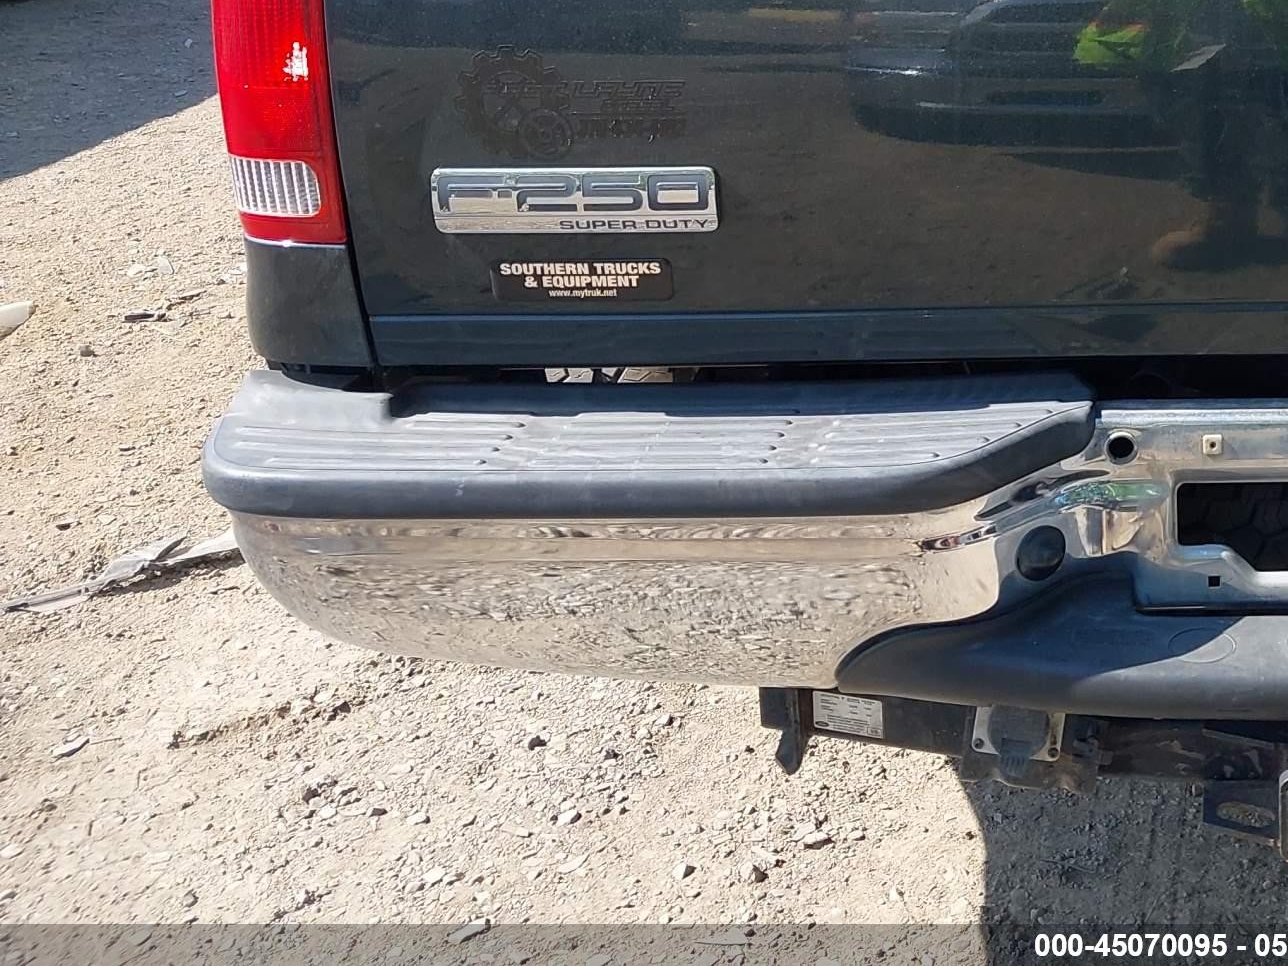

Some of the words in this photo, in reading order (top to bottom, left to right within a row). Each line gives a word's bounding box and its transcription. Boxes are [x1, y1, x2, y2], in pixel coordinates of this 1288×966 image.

[559, 219, 638, 230] SUPER
[645, 218, 708, 229] DUTY
[500, 263, 590, 275] SOUTHERN
[594, 262, 661, 275] TRUCKS
[524, 276, 538, 288] &
[542, 275, 639, 288] EQUIPMENT
[548, 288, 617, 298] www.mytruk.net
